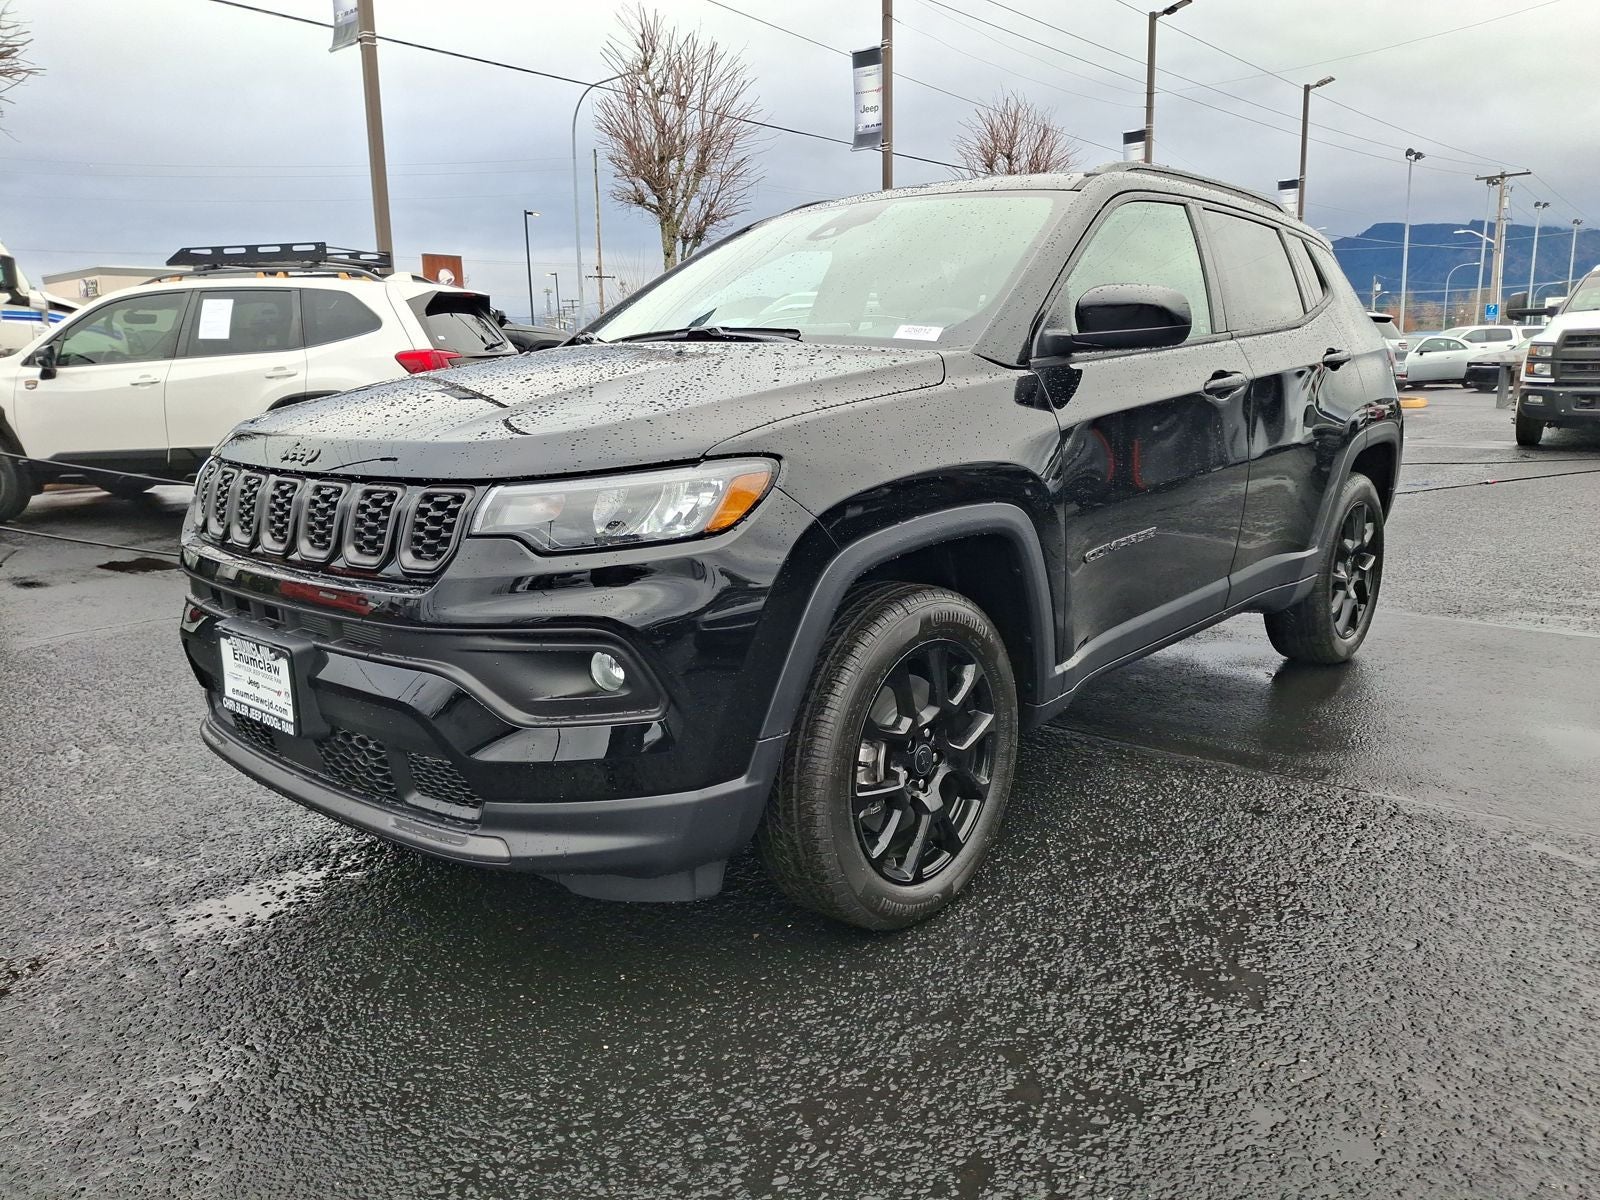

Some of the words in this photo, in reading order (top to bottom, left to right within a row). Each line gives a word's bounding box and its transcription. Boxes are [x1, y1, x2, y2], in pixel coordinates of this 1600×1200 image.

[860, 104, 879, 113] Jeep
[280, 442, 321, 467] Jeep
[930, 607, 988, 640] Continental
[232, 648, 279, 675] Enumclaw
